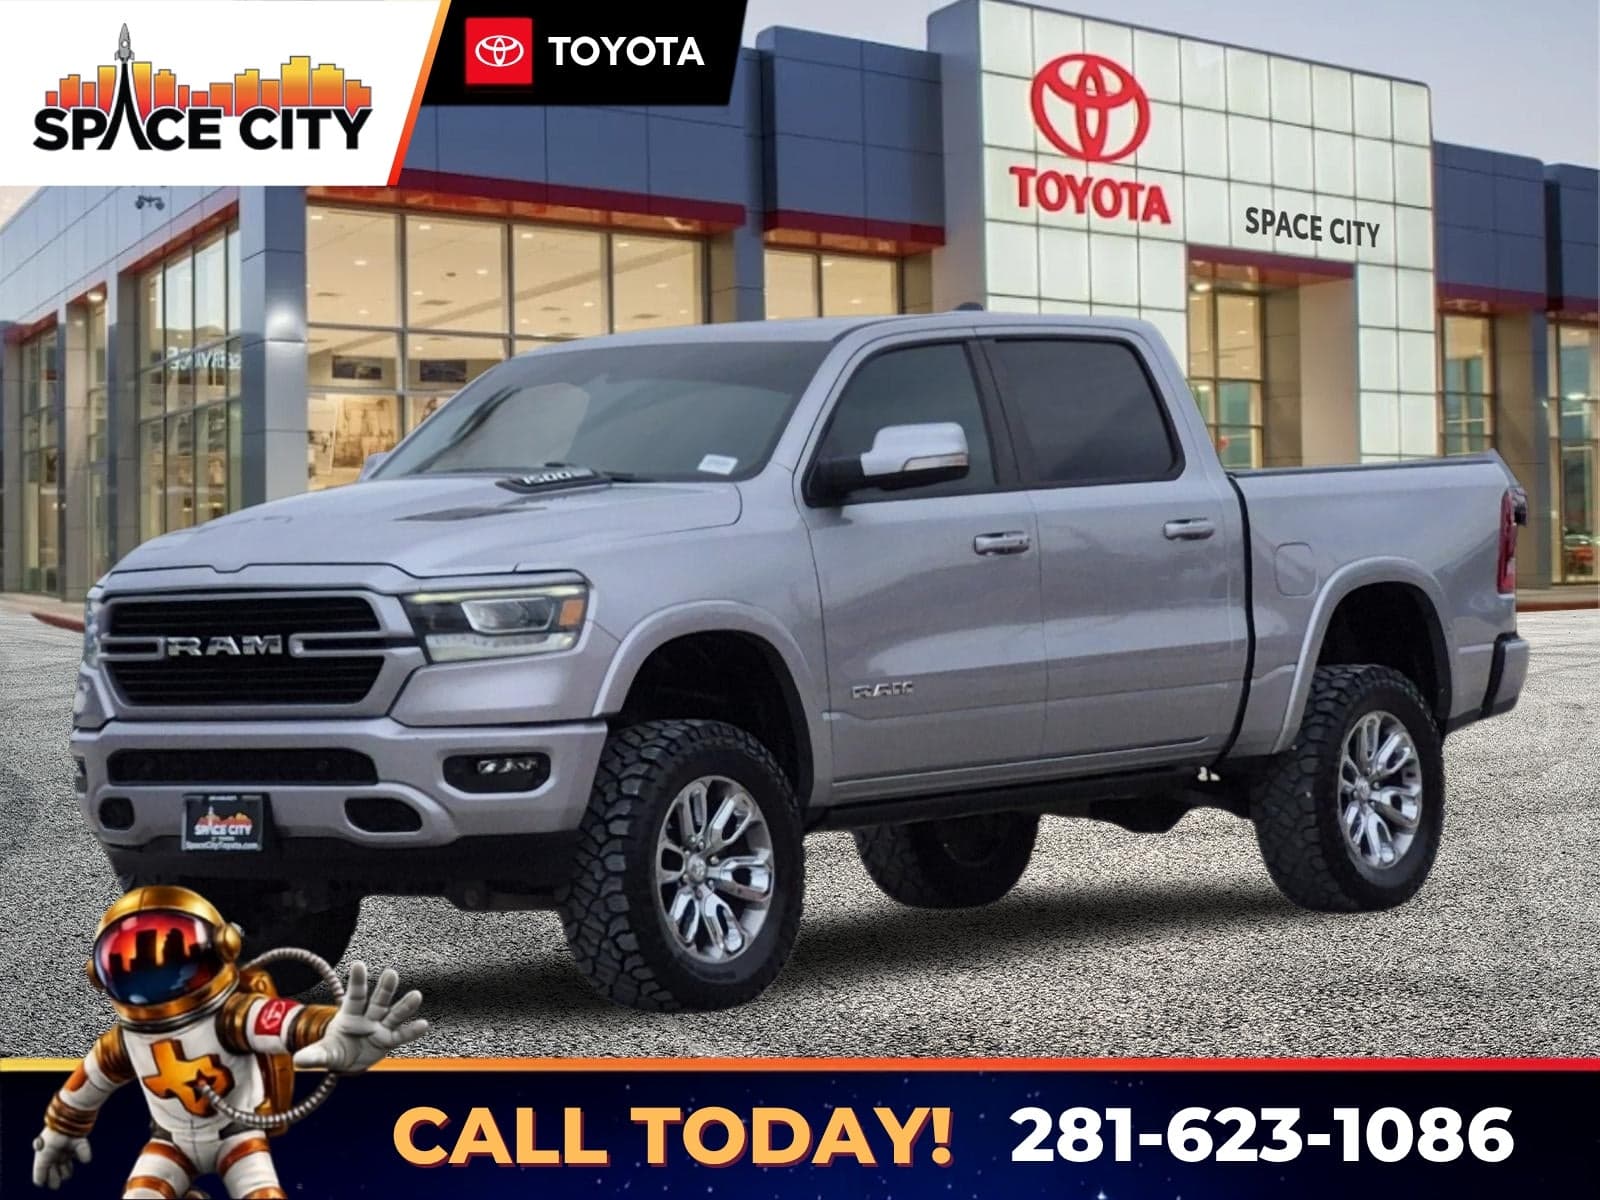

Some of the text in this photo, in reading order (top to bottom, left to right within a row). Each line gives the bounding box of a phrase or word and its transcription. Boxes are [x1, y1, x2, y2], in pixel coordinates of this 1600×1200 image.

[1009, 166, 1171, 224] TOYOTA
[1245, 207, 1380, 248] SPACE CITY
[167, 635, 282, 656] RAM
[852, 681, 913, 699] RAM
[194, 824, 252, 836] SPACE CITY
